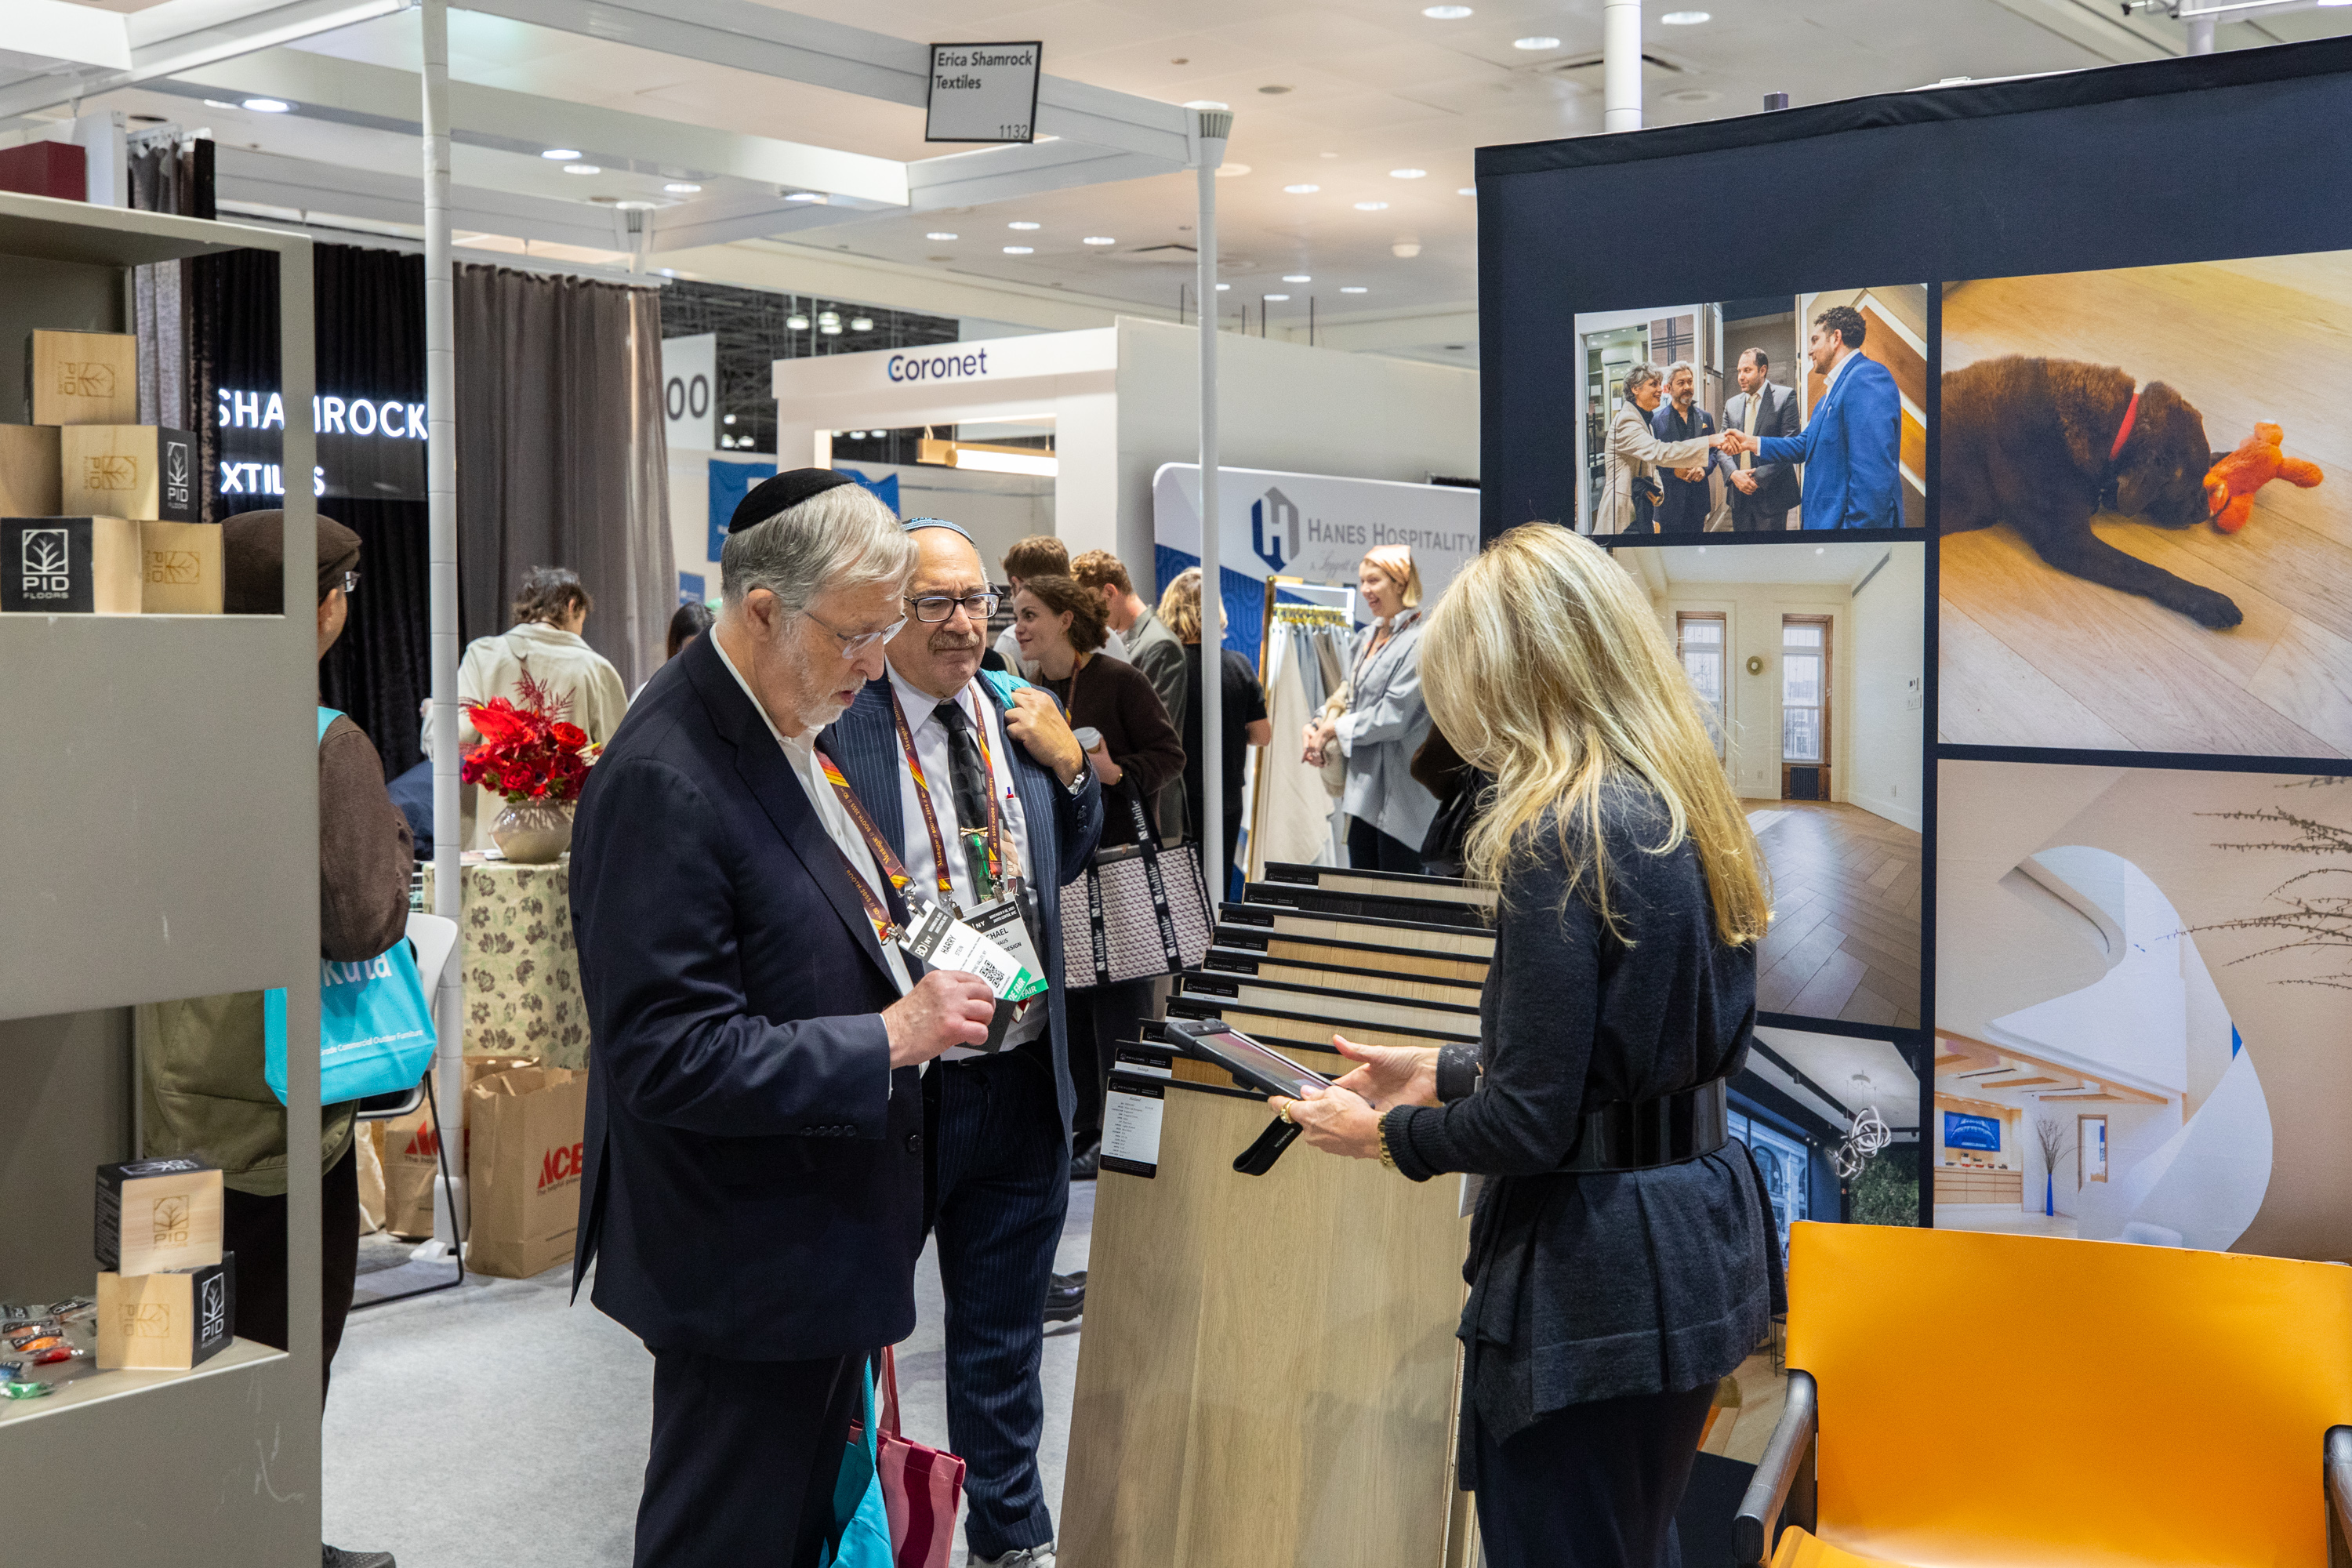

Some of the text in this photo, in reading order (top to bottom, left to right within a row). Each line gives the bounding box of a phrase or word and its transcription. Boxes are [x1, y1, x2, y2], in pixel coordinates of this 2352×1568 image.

[937, 50, 1033, 67] Erica Shamrock
[935, 74, 982, 89] Textiles
[999, 124, 1029, 140] 1132
[887, 347, 988, 383] Coronet
[220, 461, 325, 497] XTILS
[167, 487, 189, 503] PID
[1308, 518, 1475, 553] HANES HOSPITALITY
[22, 576, 70, 591] PID
[1131, 800, 1147, 830] daltile
[1149, 862, 1163, 895] daltile
[1089, 875, 1100, 907] daltile
[986, 927, 1009, 941] CHAEL
[1160, 915, 1175, 946] daltile
[940, 934, 956, 955] HARRY
[1094, 928, 1105, 961] daltile
[1014, 977, 1026, 993] FAIR
[1021, 985, 1037, 997] FAIR
[337, 1036, 373, 1052] Commercial
[396, 1029, 423, 1040] Furniture
[537, 1141, 584, 1189] ACE
[154, 1230, 188, 1244] PID
[202, 1318, 224, 1341] PID
